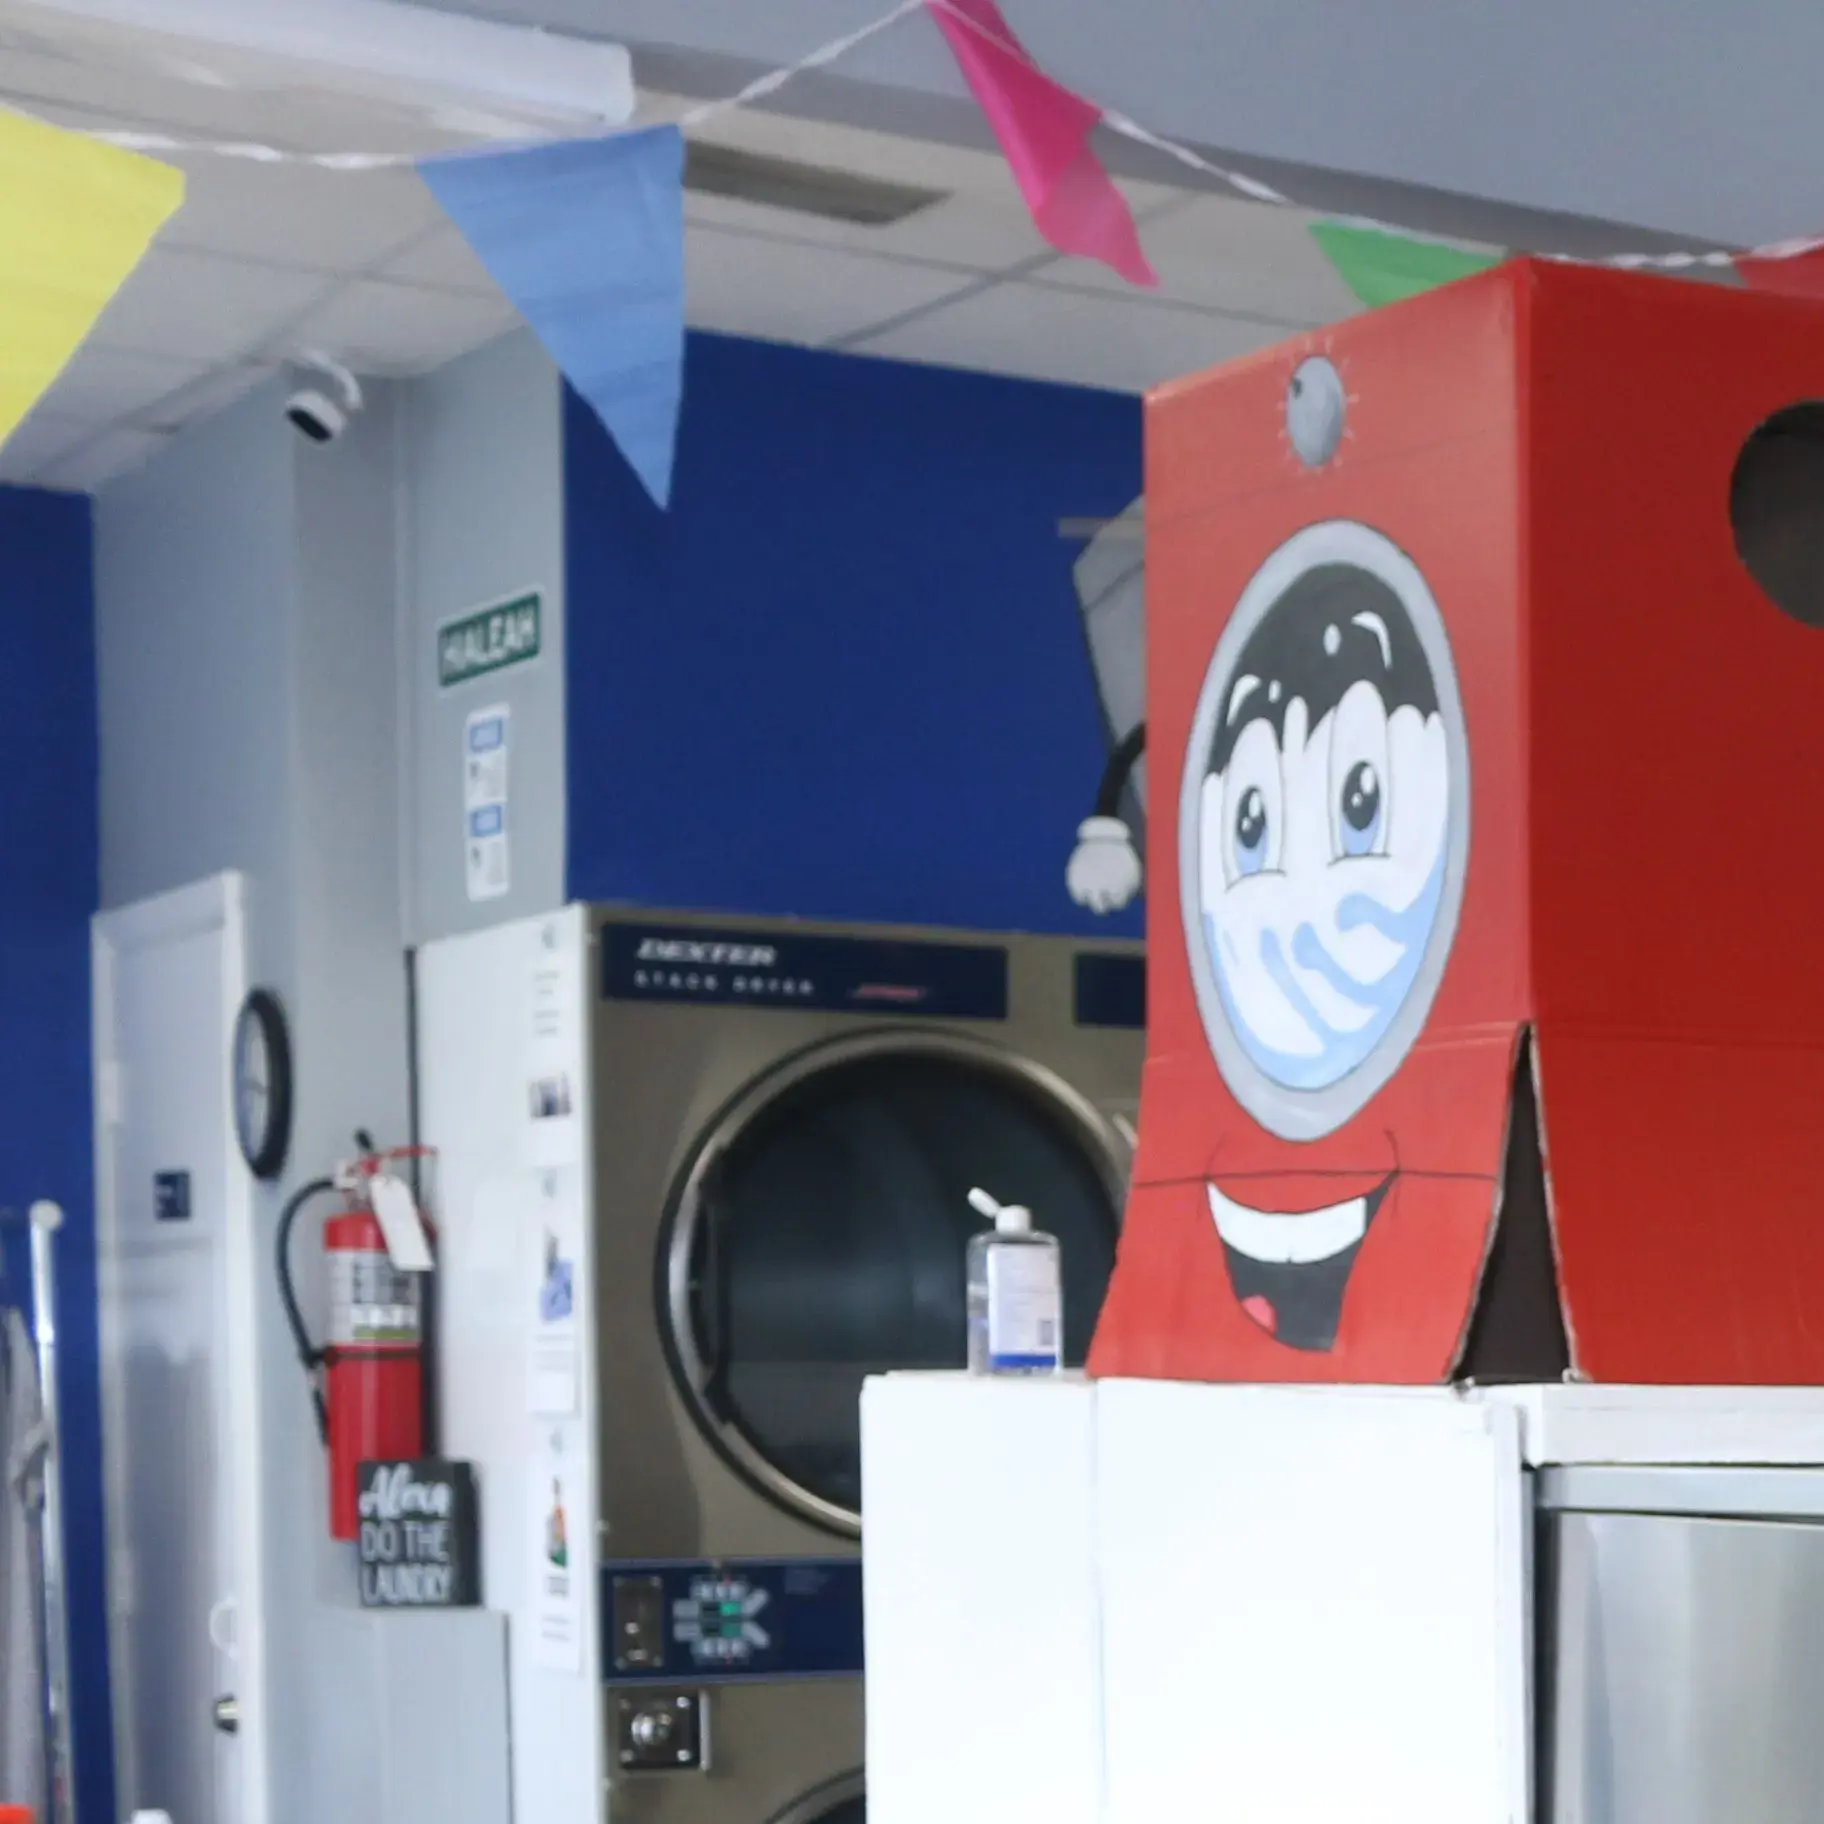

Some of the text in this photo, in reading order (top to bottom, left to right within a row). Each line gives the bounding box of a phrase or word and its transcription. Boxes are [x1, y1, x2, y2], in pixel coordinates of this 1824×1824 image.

[637, 937, 778, 967] DEXTER
[361, 1521, 450, 1562] DO THE
[363, 1563, 453, 1606] LAUNDRY
